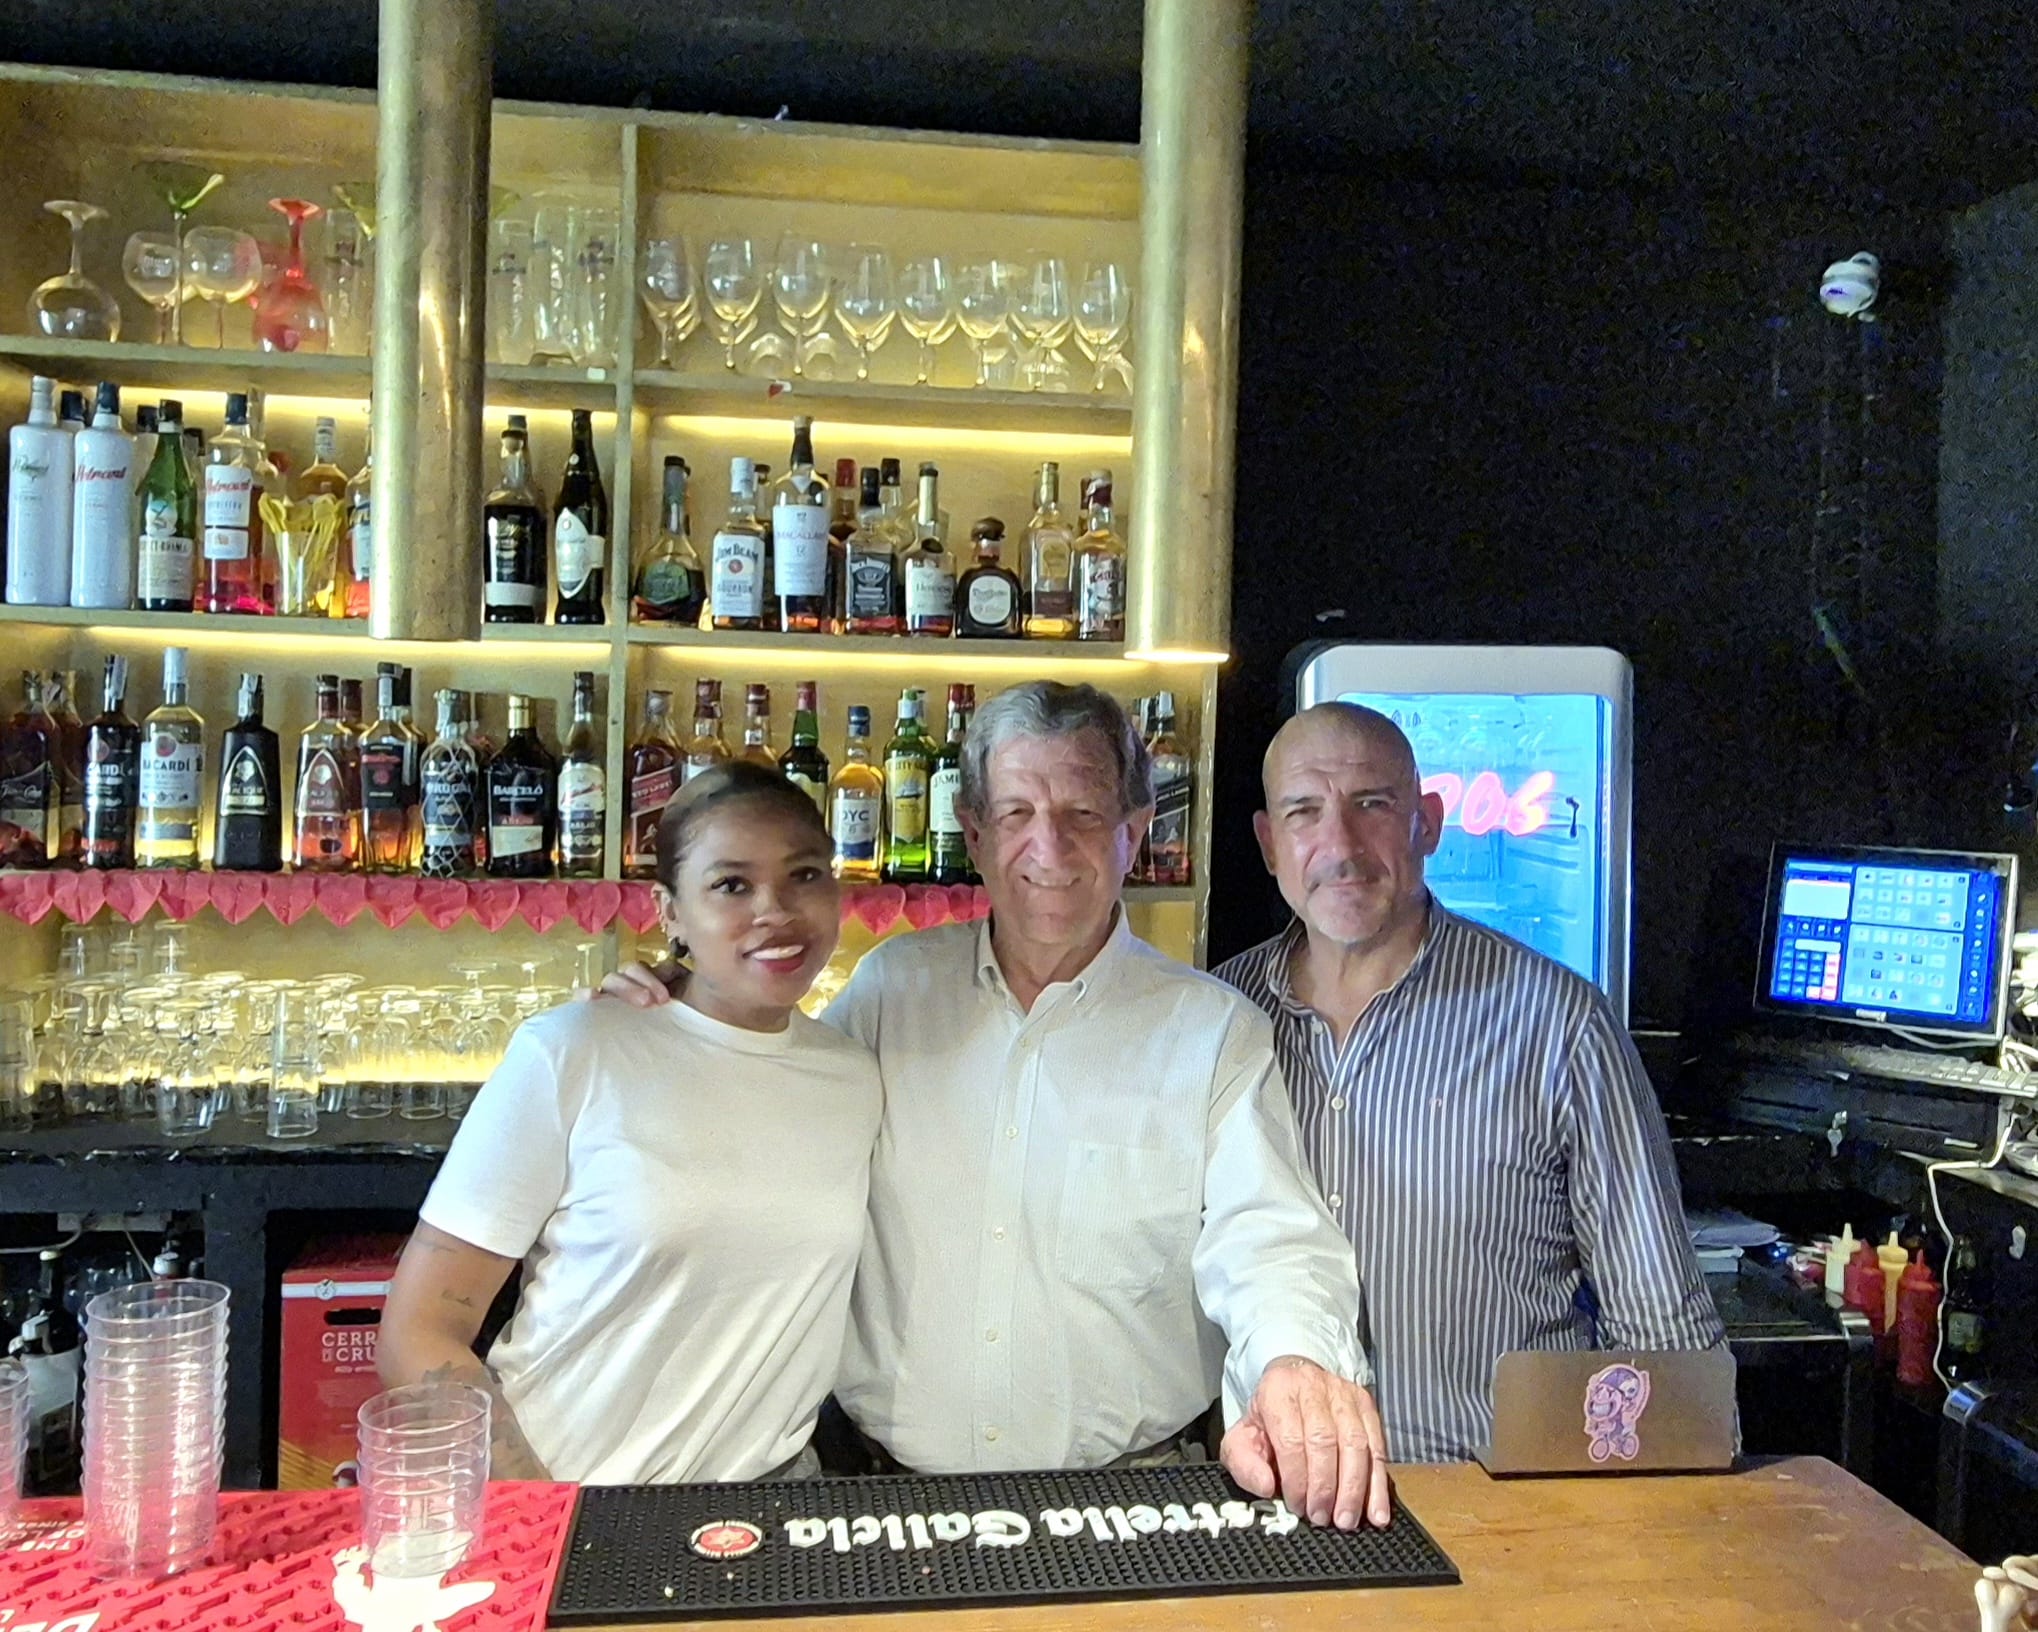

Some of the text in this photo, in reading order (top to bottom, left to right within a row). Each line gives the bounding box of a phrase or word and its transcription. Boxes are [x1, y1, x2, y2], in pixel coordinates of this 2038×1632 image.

[715, 542, 759, 563] JIM BEAM
[142, 756, 191, 772] CARDÍ
[784, 1500, 1298, 1554] Estrella Galicia
